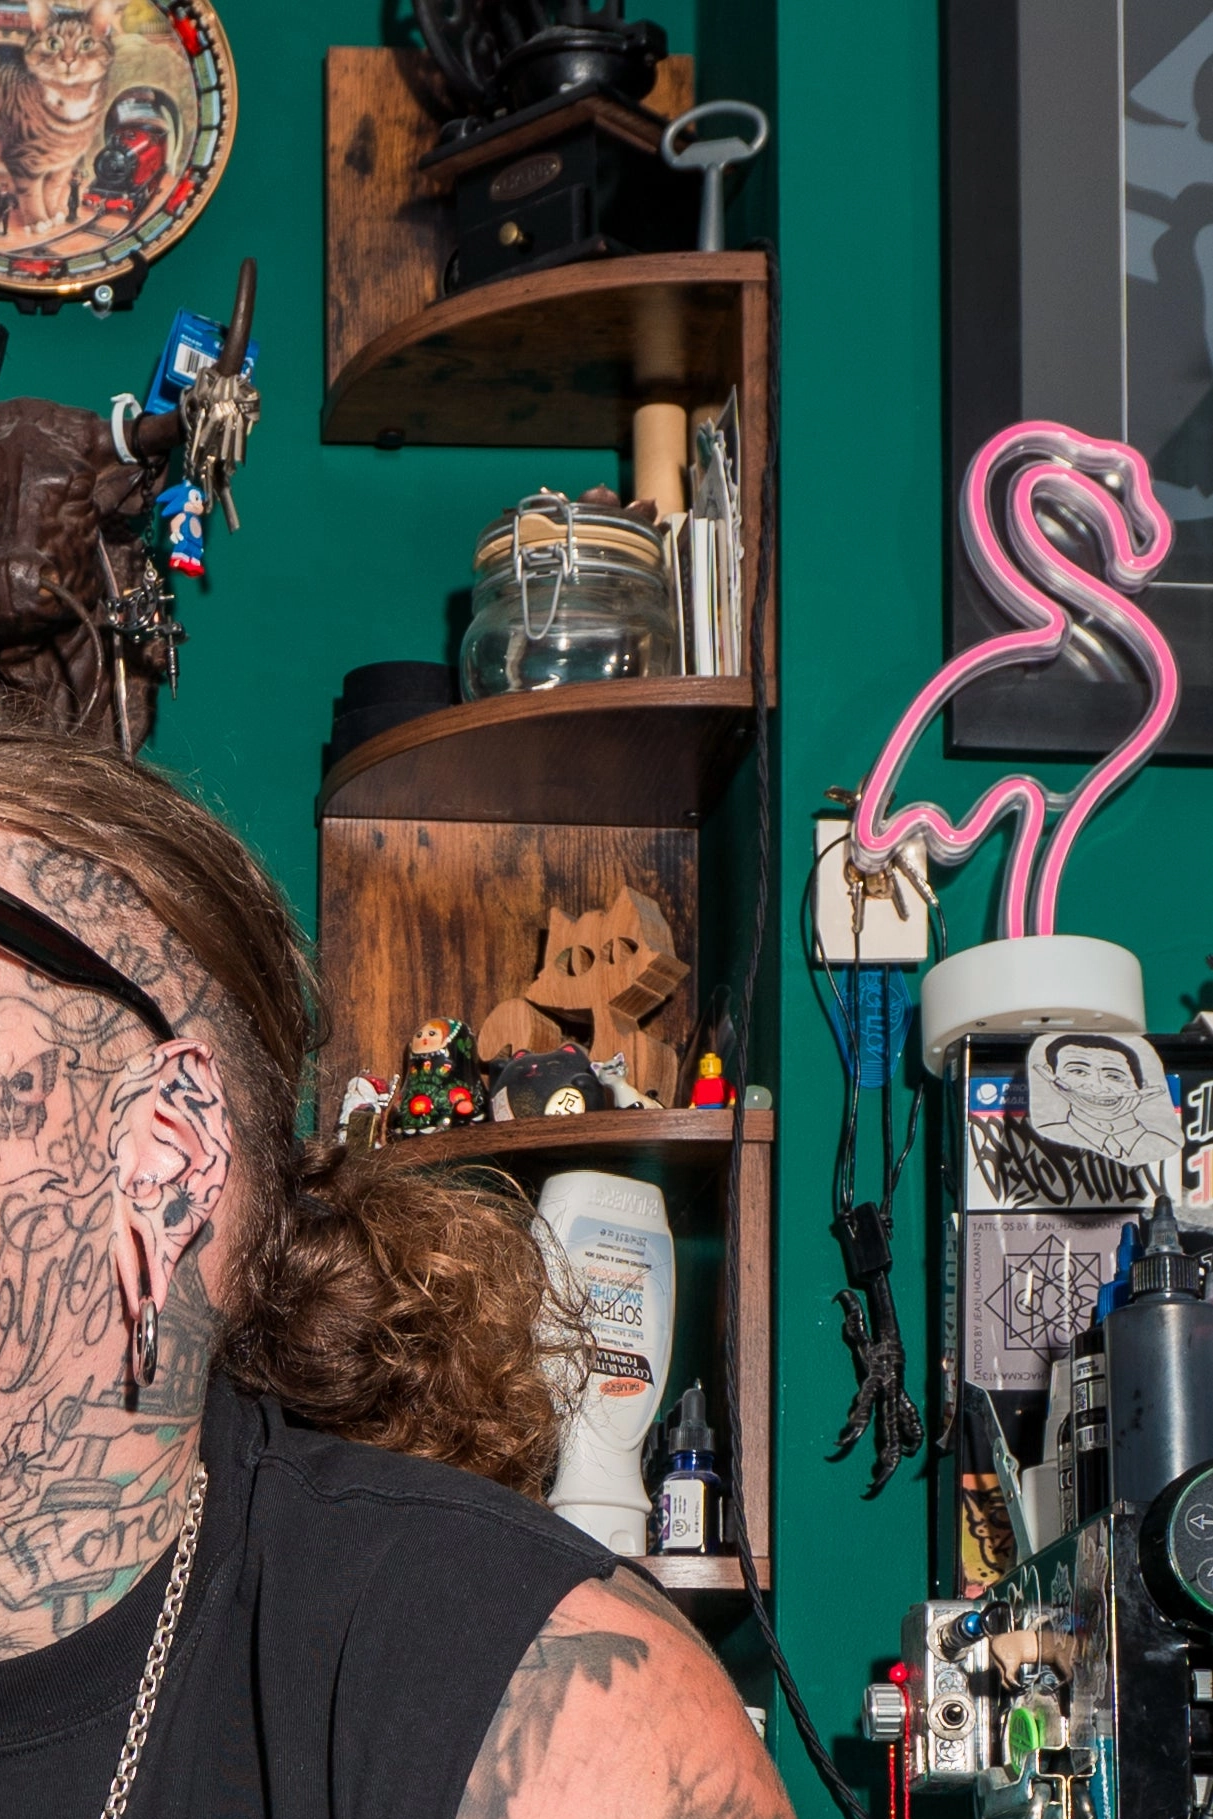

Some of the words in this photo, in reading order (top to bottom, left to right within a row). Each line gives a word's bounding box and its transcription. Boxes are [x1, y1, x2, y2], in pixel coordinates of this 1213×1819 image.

[1002, 1083, 1028, 1093] PRIO
[1017, 1222, 1028, 1231] BY
[589, 1299, 643, 1327] SOFTEN
[973, 1325, 983, 1338] BY
[973, 1340, 983, 1381] TATTOOS
[618, 1364, 650, 1380] COCOA
